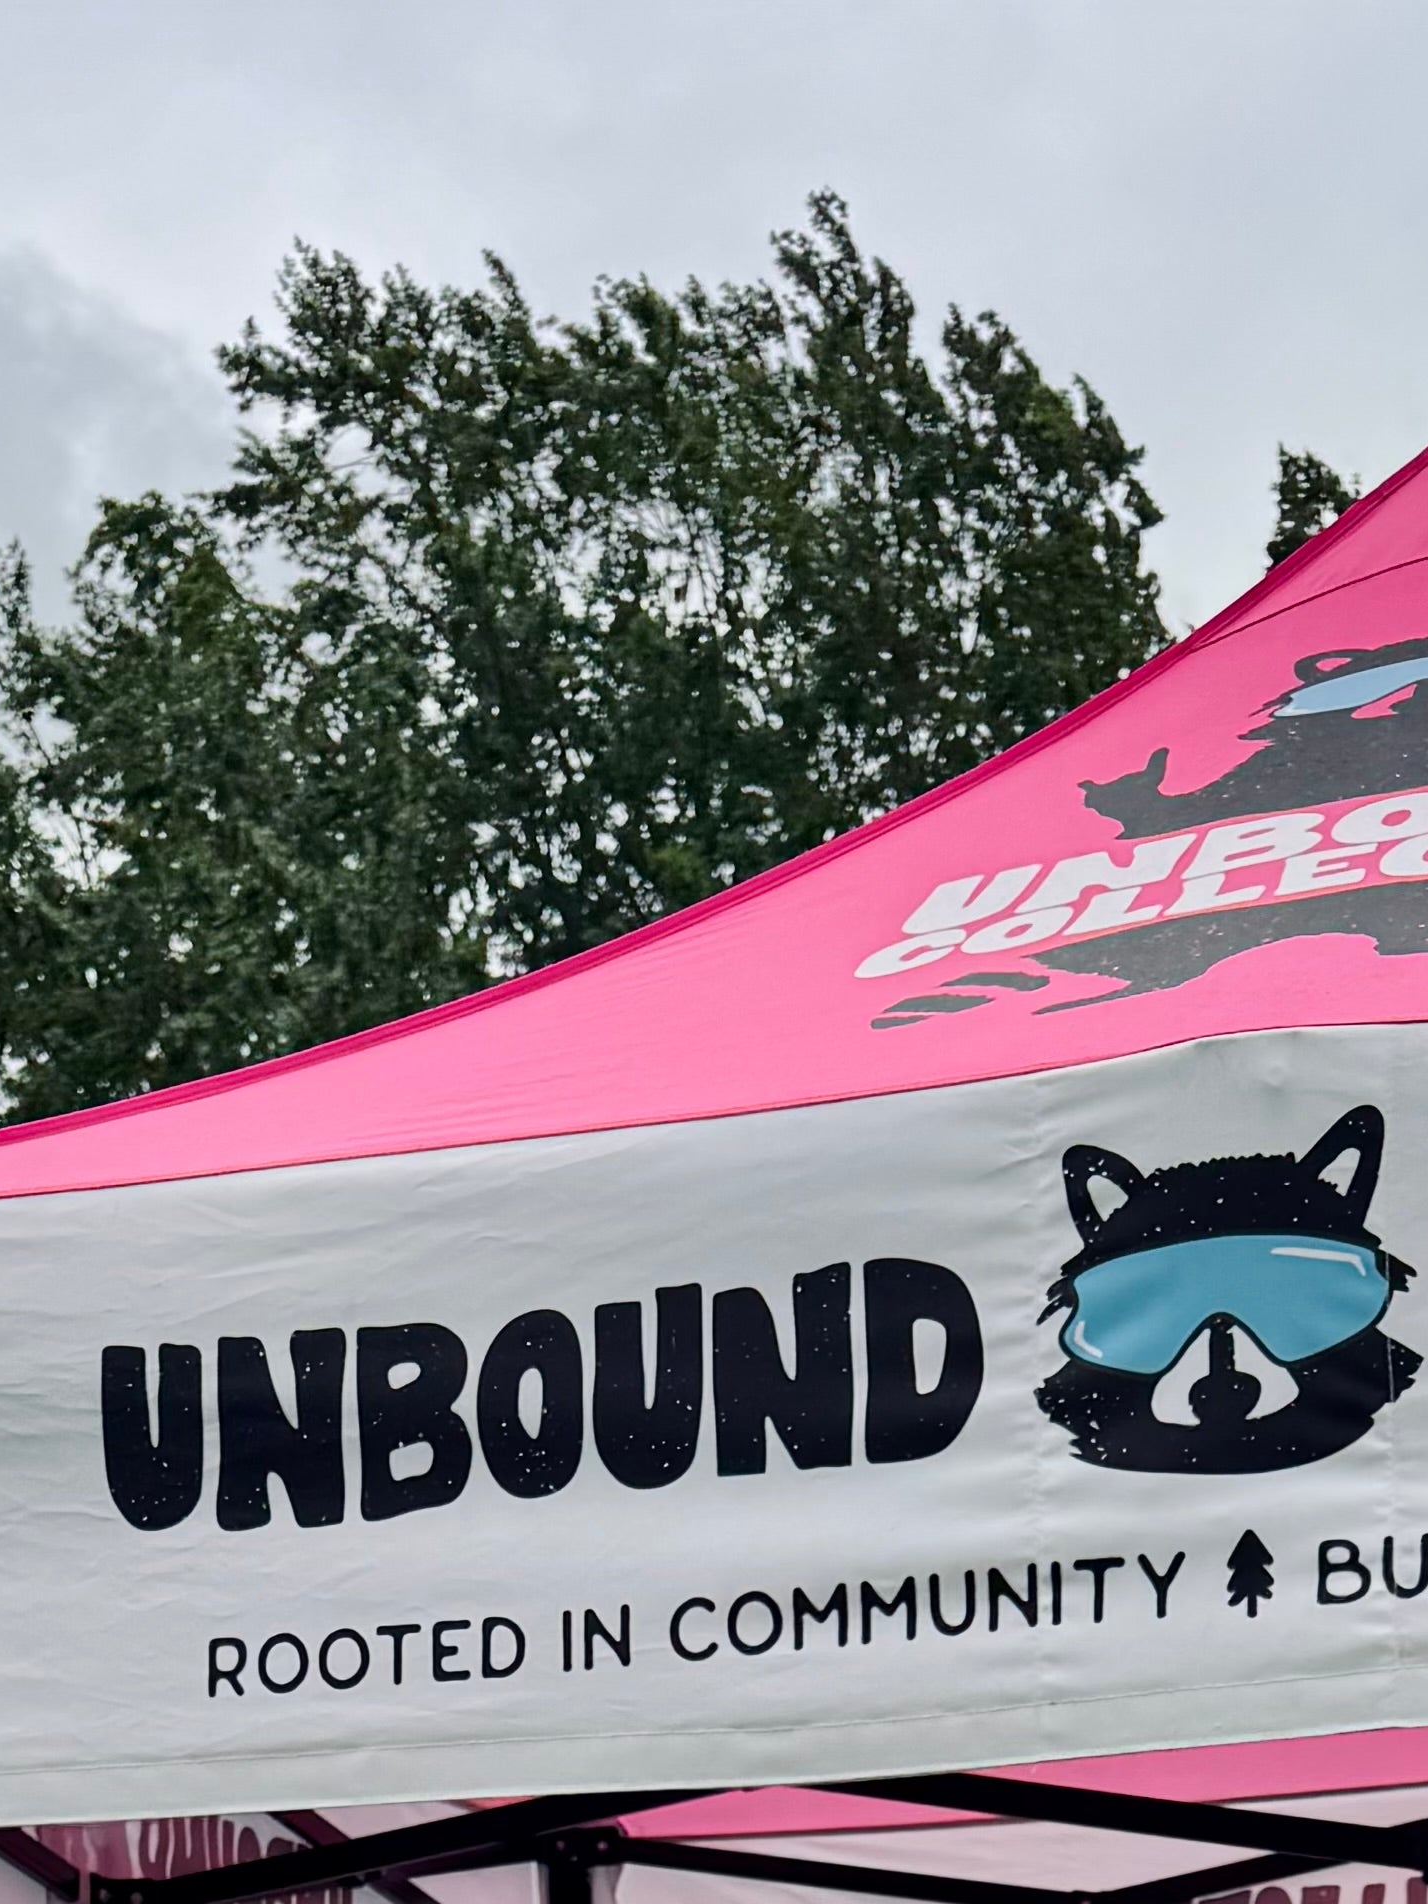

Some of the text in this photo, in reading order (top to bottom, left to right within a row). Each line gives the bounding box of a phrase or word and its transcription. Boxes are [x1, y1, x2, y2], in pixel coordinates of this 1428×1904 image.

[101, 1257, 984, 1531] UNBOUND
[208, 1615, 525, 1697] ROOTED
[563, 1604, 632, 1673] IN
[669, 1550, 1186, 1662] COMMUNITY
